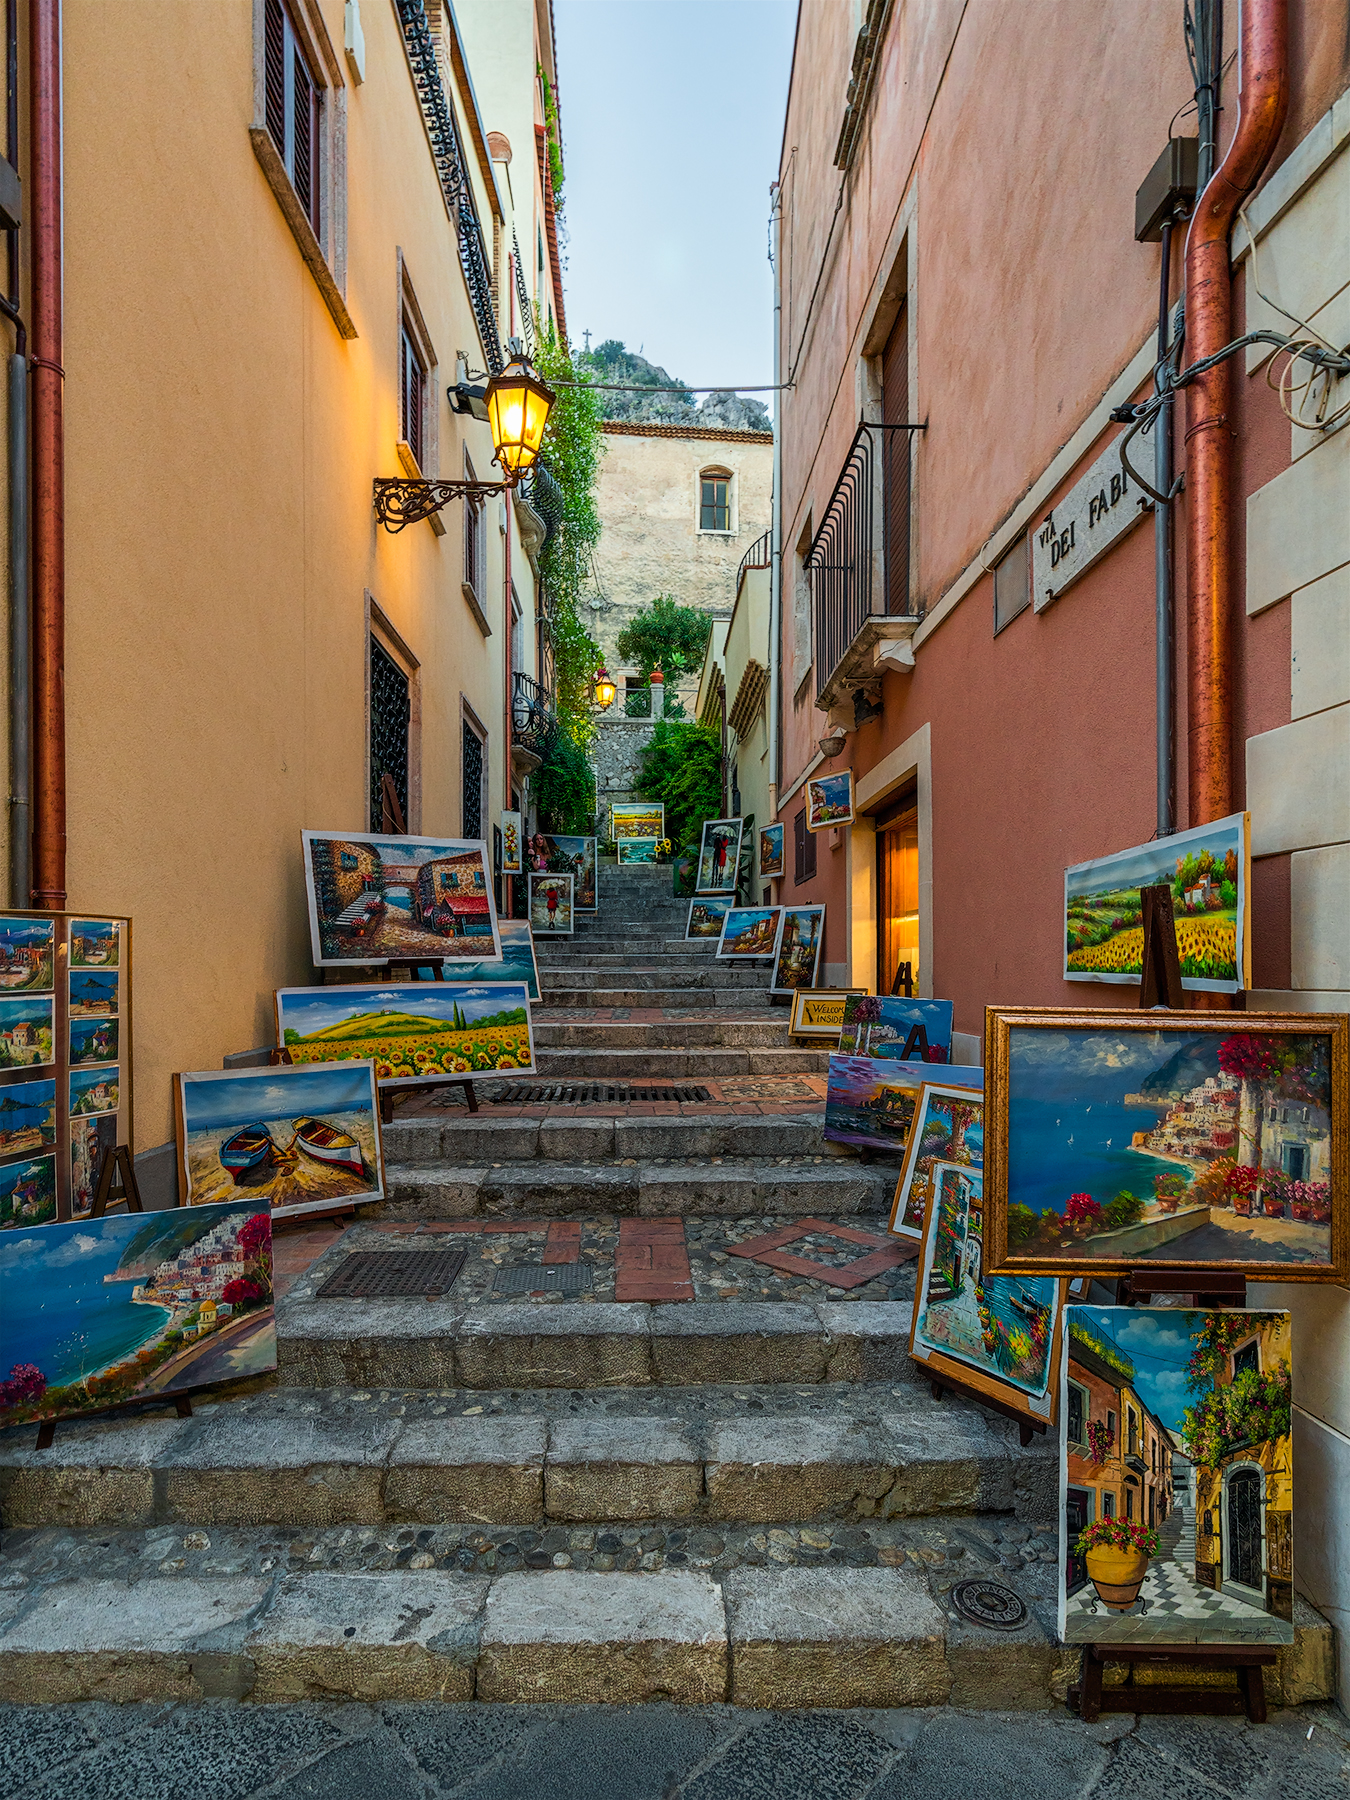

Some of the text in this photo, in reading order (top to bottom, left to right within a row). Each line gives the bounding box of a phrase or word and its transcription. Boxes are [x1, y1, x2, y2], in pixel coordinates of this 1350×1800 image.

[1039, 521, 1056, 548] VIA
[1051, 520, 1075, 568] DEI
[812, 1003, 845, 1014] WELCOM
[816, 1014, 844, 1023] INSIDE
